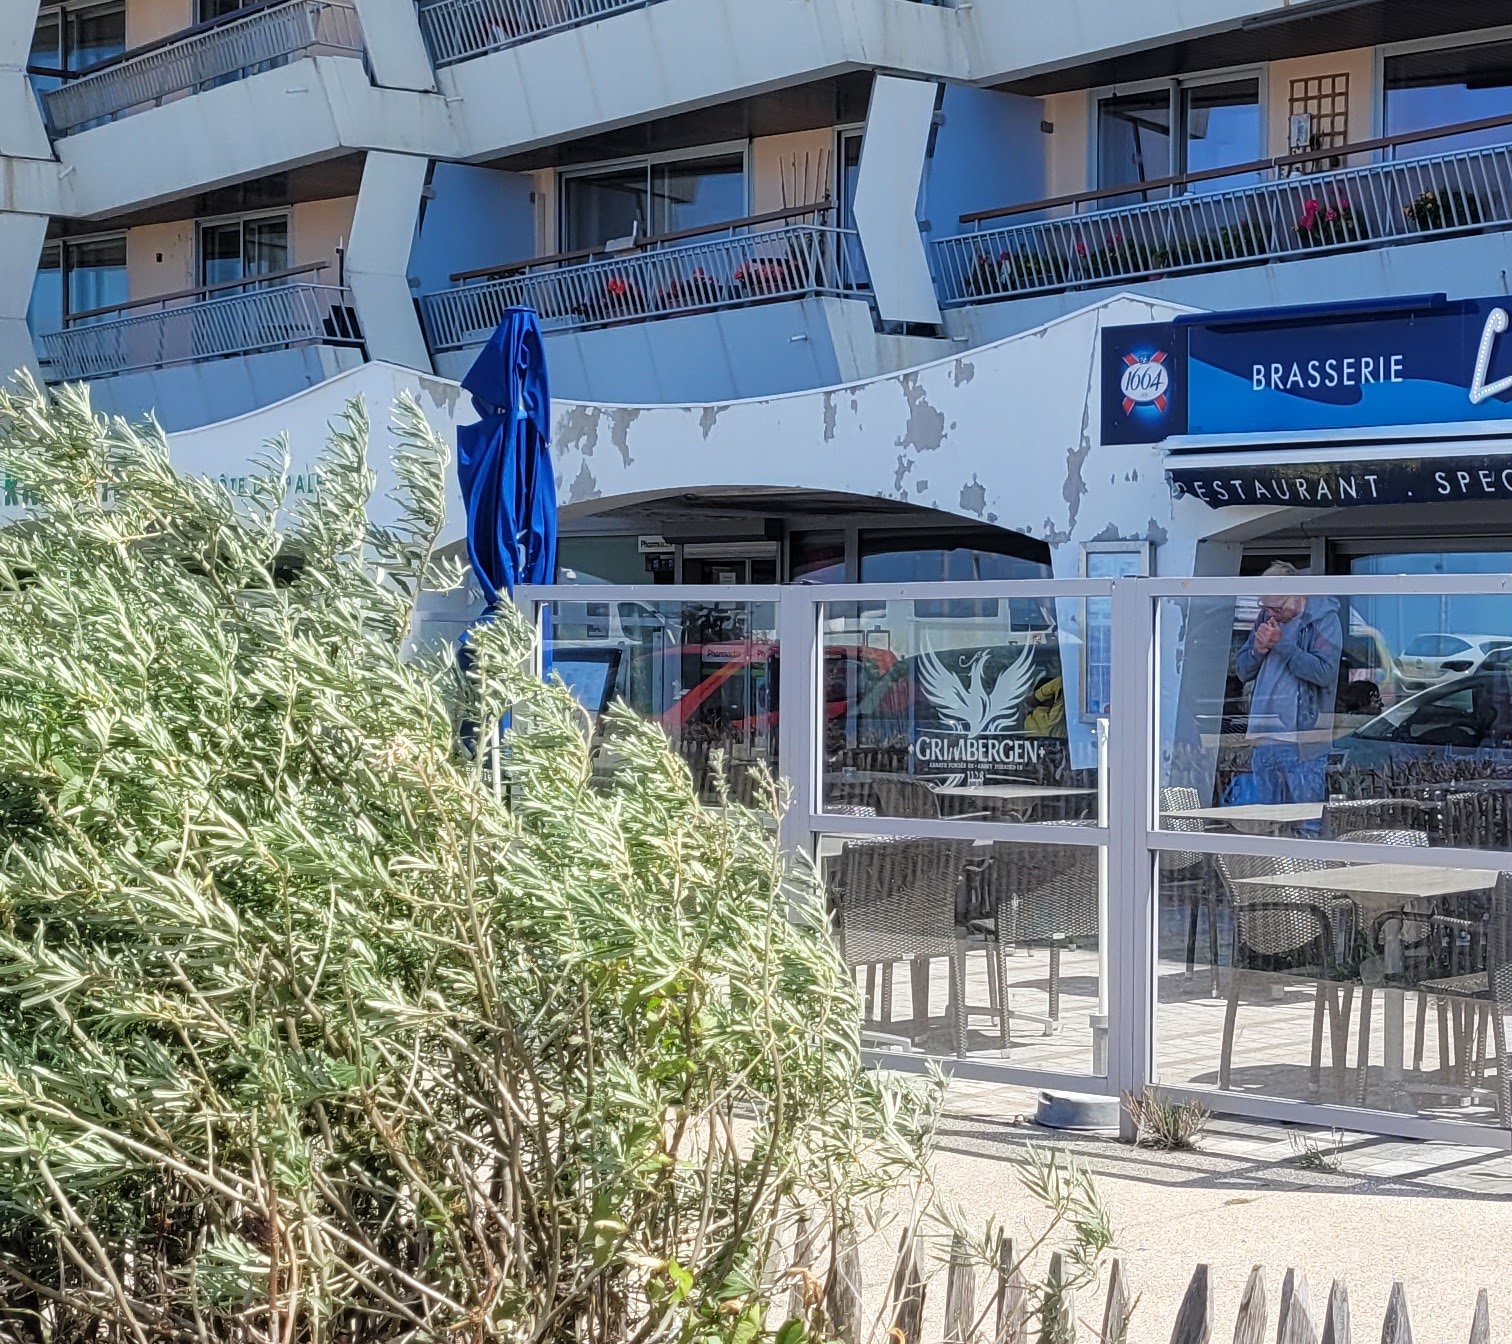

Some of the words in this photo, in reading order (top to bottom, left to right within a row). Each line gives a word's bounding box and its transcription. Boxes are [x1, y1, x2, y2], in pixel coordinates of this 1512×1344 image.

[1125, 366, 1164, 391] 1664
[1252, 355, 1403, 391] BRASSERIE
[915, 736, 1038, 763] GRIMBERGEN
